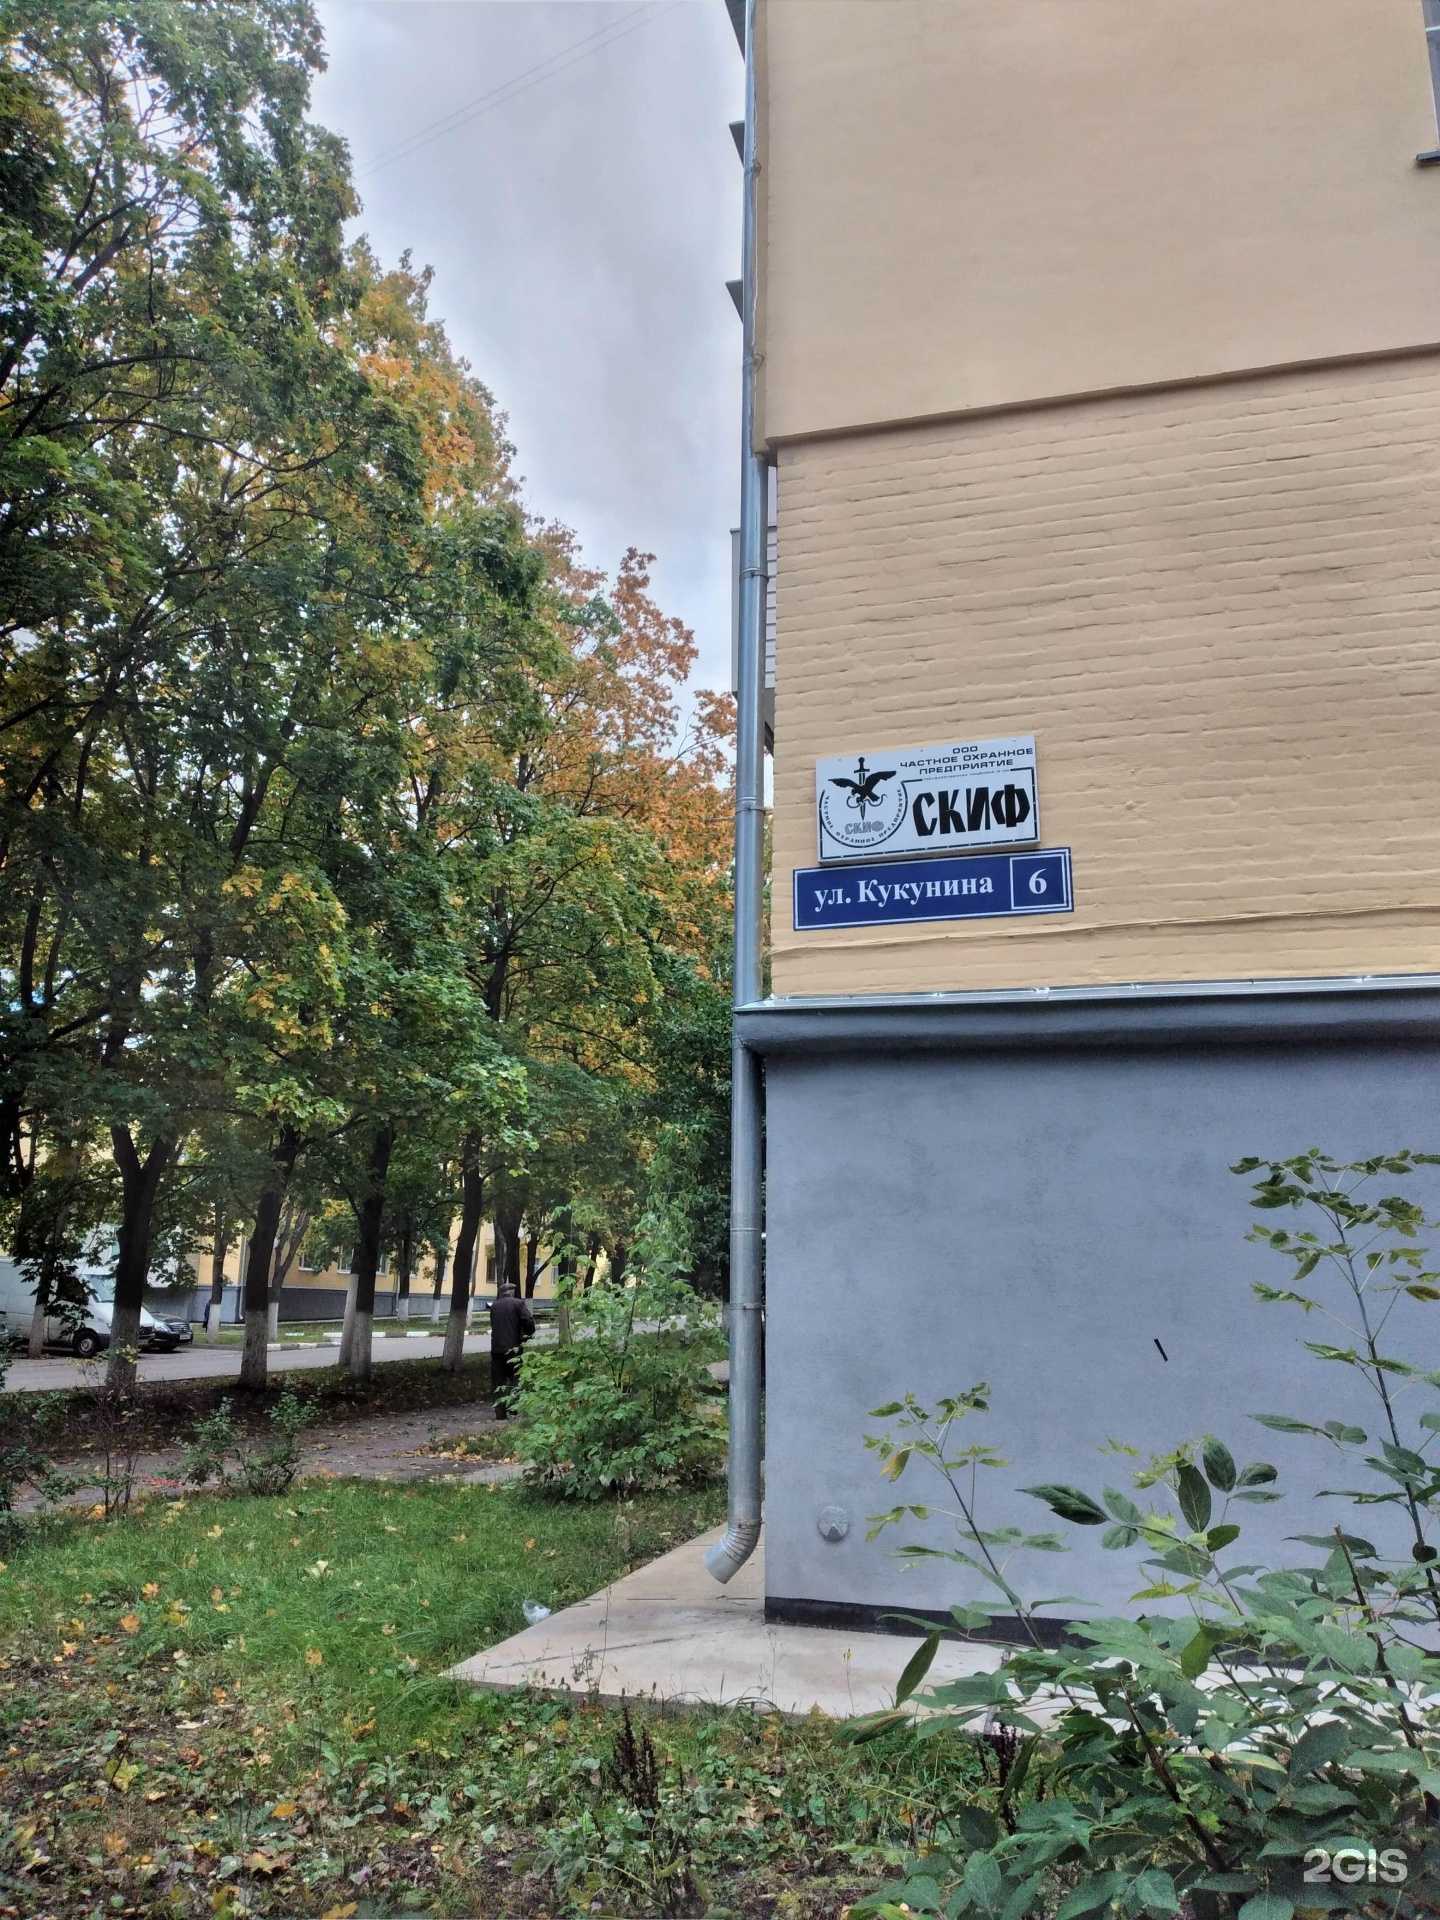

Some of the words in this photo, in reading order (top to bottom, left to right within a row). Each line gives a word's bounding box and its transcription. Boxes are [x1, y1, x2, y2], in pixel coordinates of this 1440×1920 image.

[900, 755, 958, 768] ЧАСТНОЕ
[963, 747, 1033, 761] ОХРАННОЕ
[952, 745, 978, 754] ООО
[919, 758, 1014, 775] ПРЕДПРИЯТИЕ
[912, 784, 1031, 837] СКИФ
[844, 820, 885, 835] СКИФ
[814, 888, 851, 912] ул.
[857, 876, 994, 908] Кукунина
[1028, 868, 1049, 895] 6
